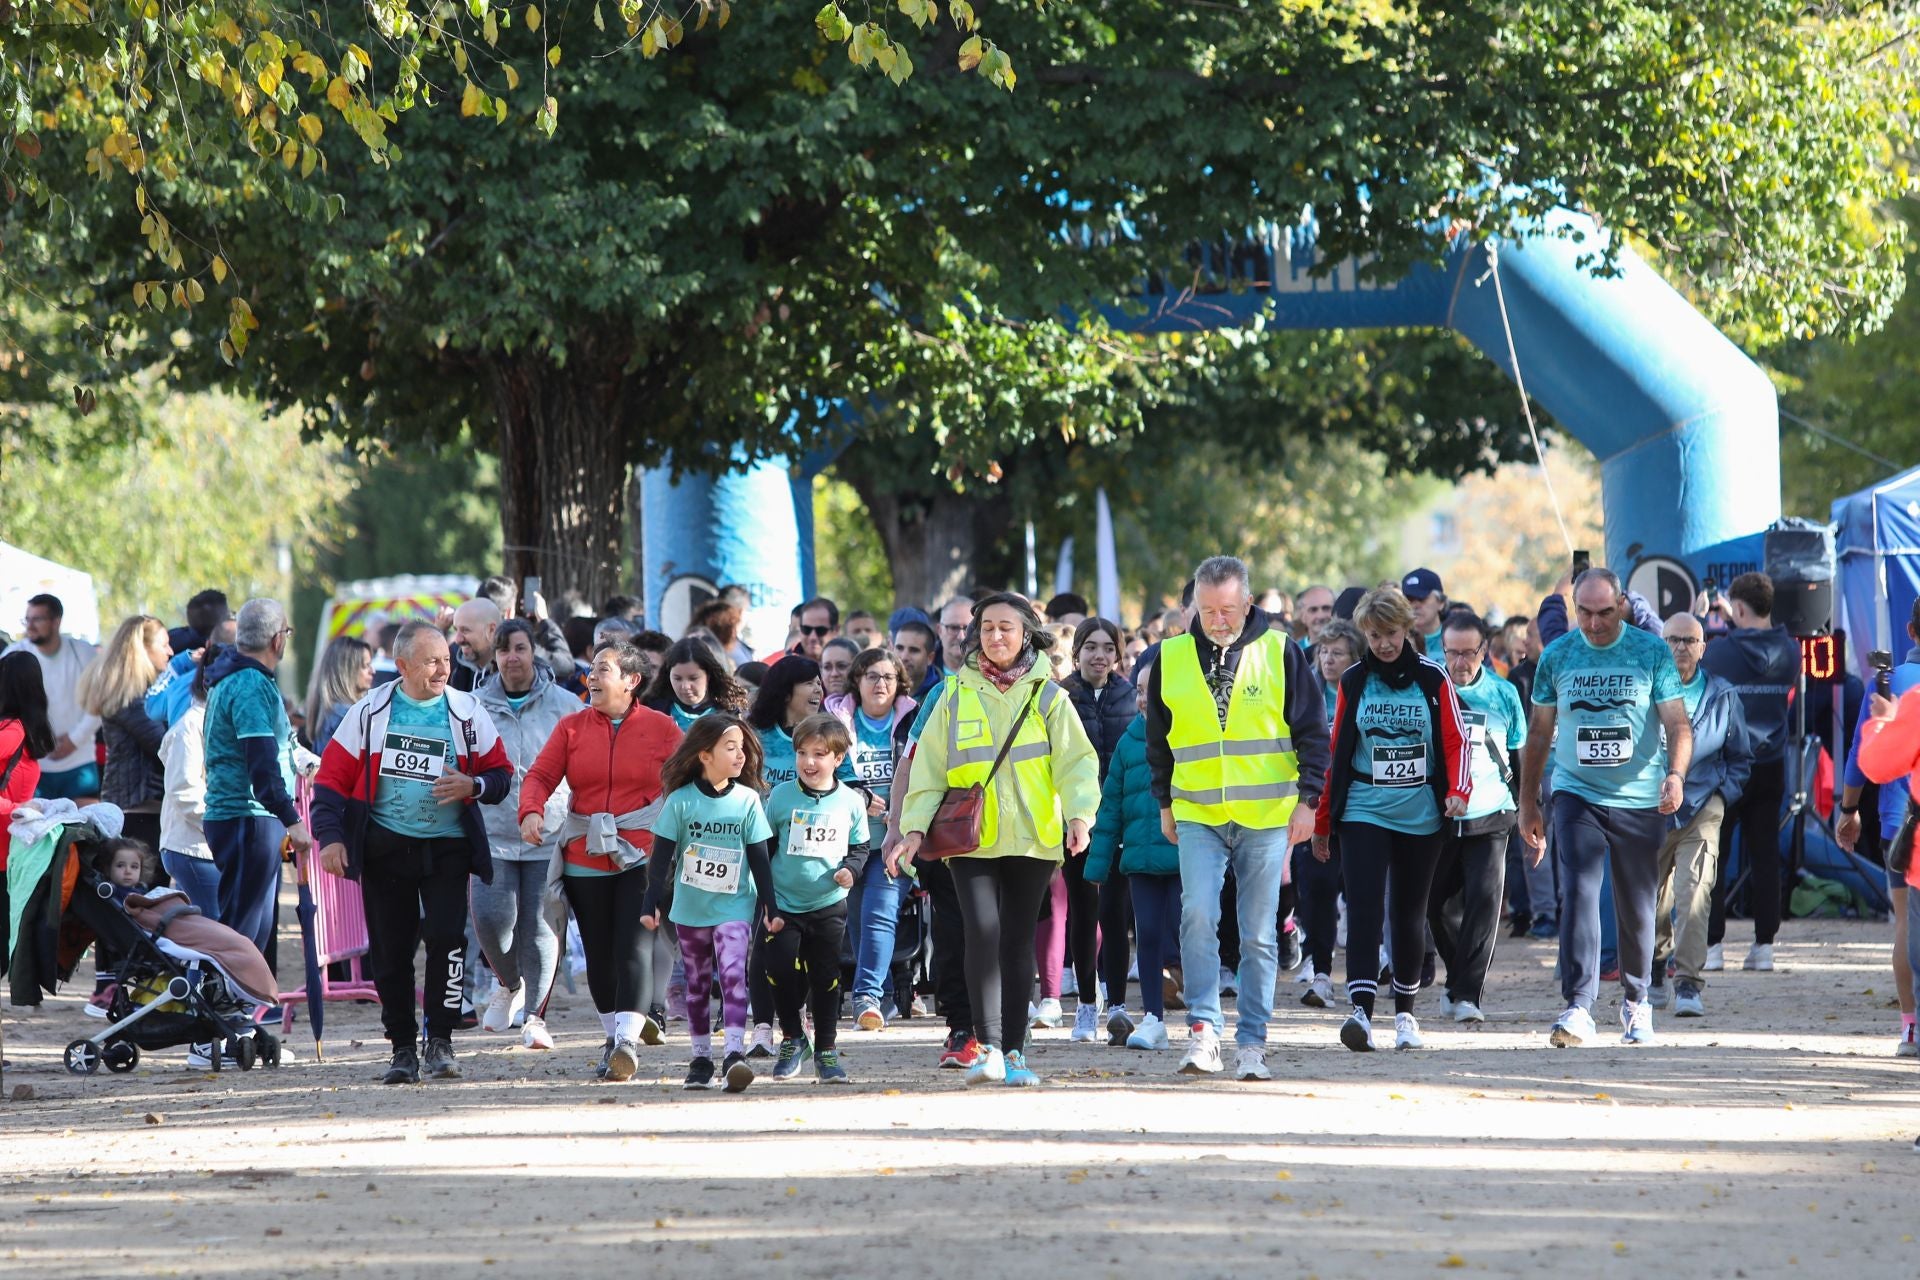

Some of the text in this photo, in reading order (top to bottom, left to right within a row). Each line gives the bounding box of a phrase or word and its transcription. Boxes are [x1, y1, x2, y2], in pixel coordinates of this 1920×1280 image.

[1573, 671, 1634, 689] MUÉVETE
[1568, 688, 1639, 697] POR LA DIABETES
[1364, 700, 1423, 717] MUÉVETE
[1360, 716, 1427, 728] POR LA DIABETES
[1590, 742, 1621, 758] 553
[394, 752, 430, 773] 694
[863, 762, 892, 779] 556
[1384, 761, 1417, 778] 424
[805, 827, 837, 842] 132
[694, 859, 728, 878] 129
[443, 947, 464, 1009] NASA
